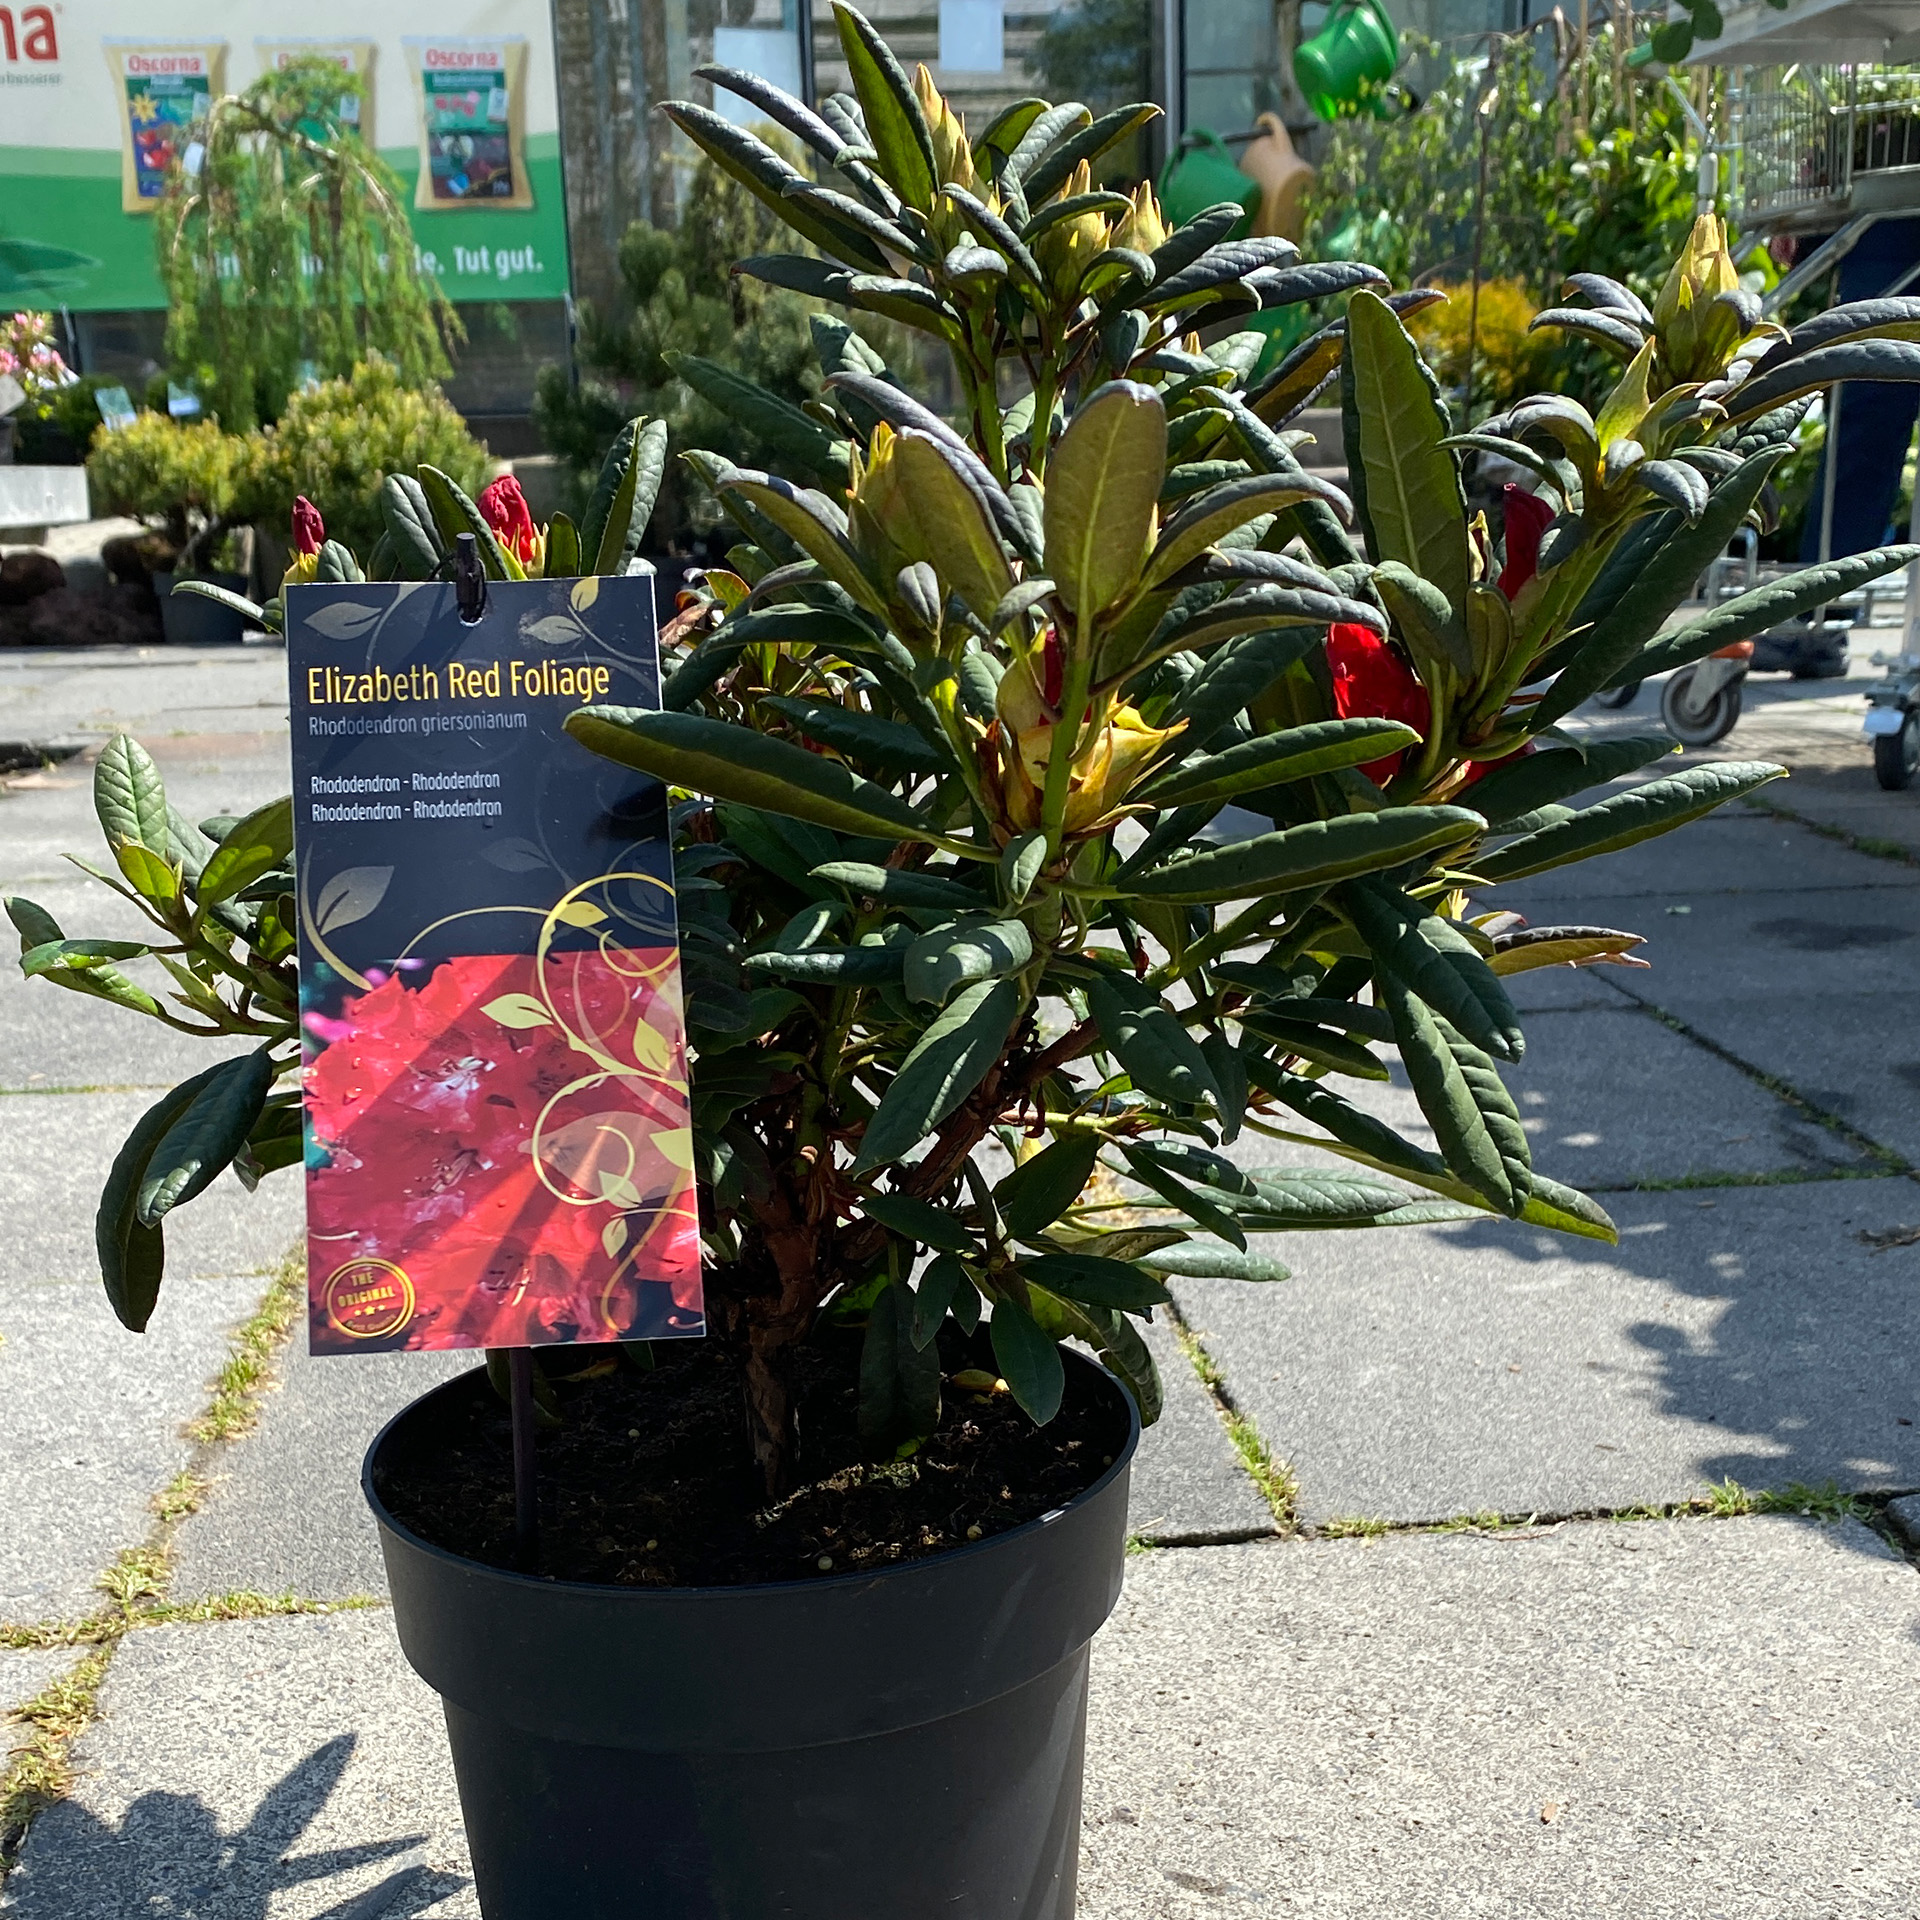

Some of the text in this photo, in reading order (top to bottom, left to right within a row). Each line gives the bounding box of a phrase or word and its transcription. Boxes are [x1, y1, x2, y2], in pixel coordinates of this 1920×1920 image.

[128, 54, 200, 74] Oscorna
[426, 48, 498, 67] Oscorna
[453, 244, 490, 275] Tut
[494, 243, 544, 281] gut.
[308, 659, 610, 704] Elizabeth Red Foliage
[309, 710, 528, 736] Rhododendron griersonianum
[310, 774, 401, 794] Rhododendron
[412, 770, 500, 791] Rhododendron
[312, 801, 402, 822] Rhododendron
[413, 798, 502, 819] Rhododendron
[350, 1271, 374, 1286] THE
[337, 1286, 395, 1307] ORIGINAL
